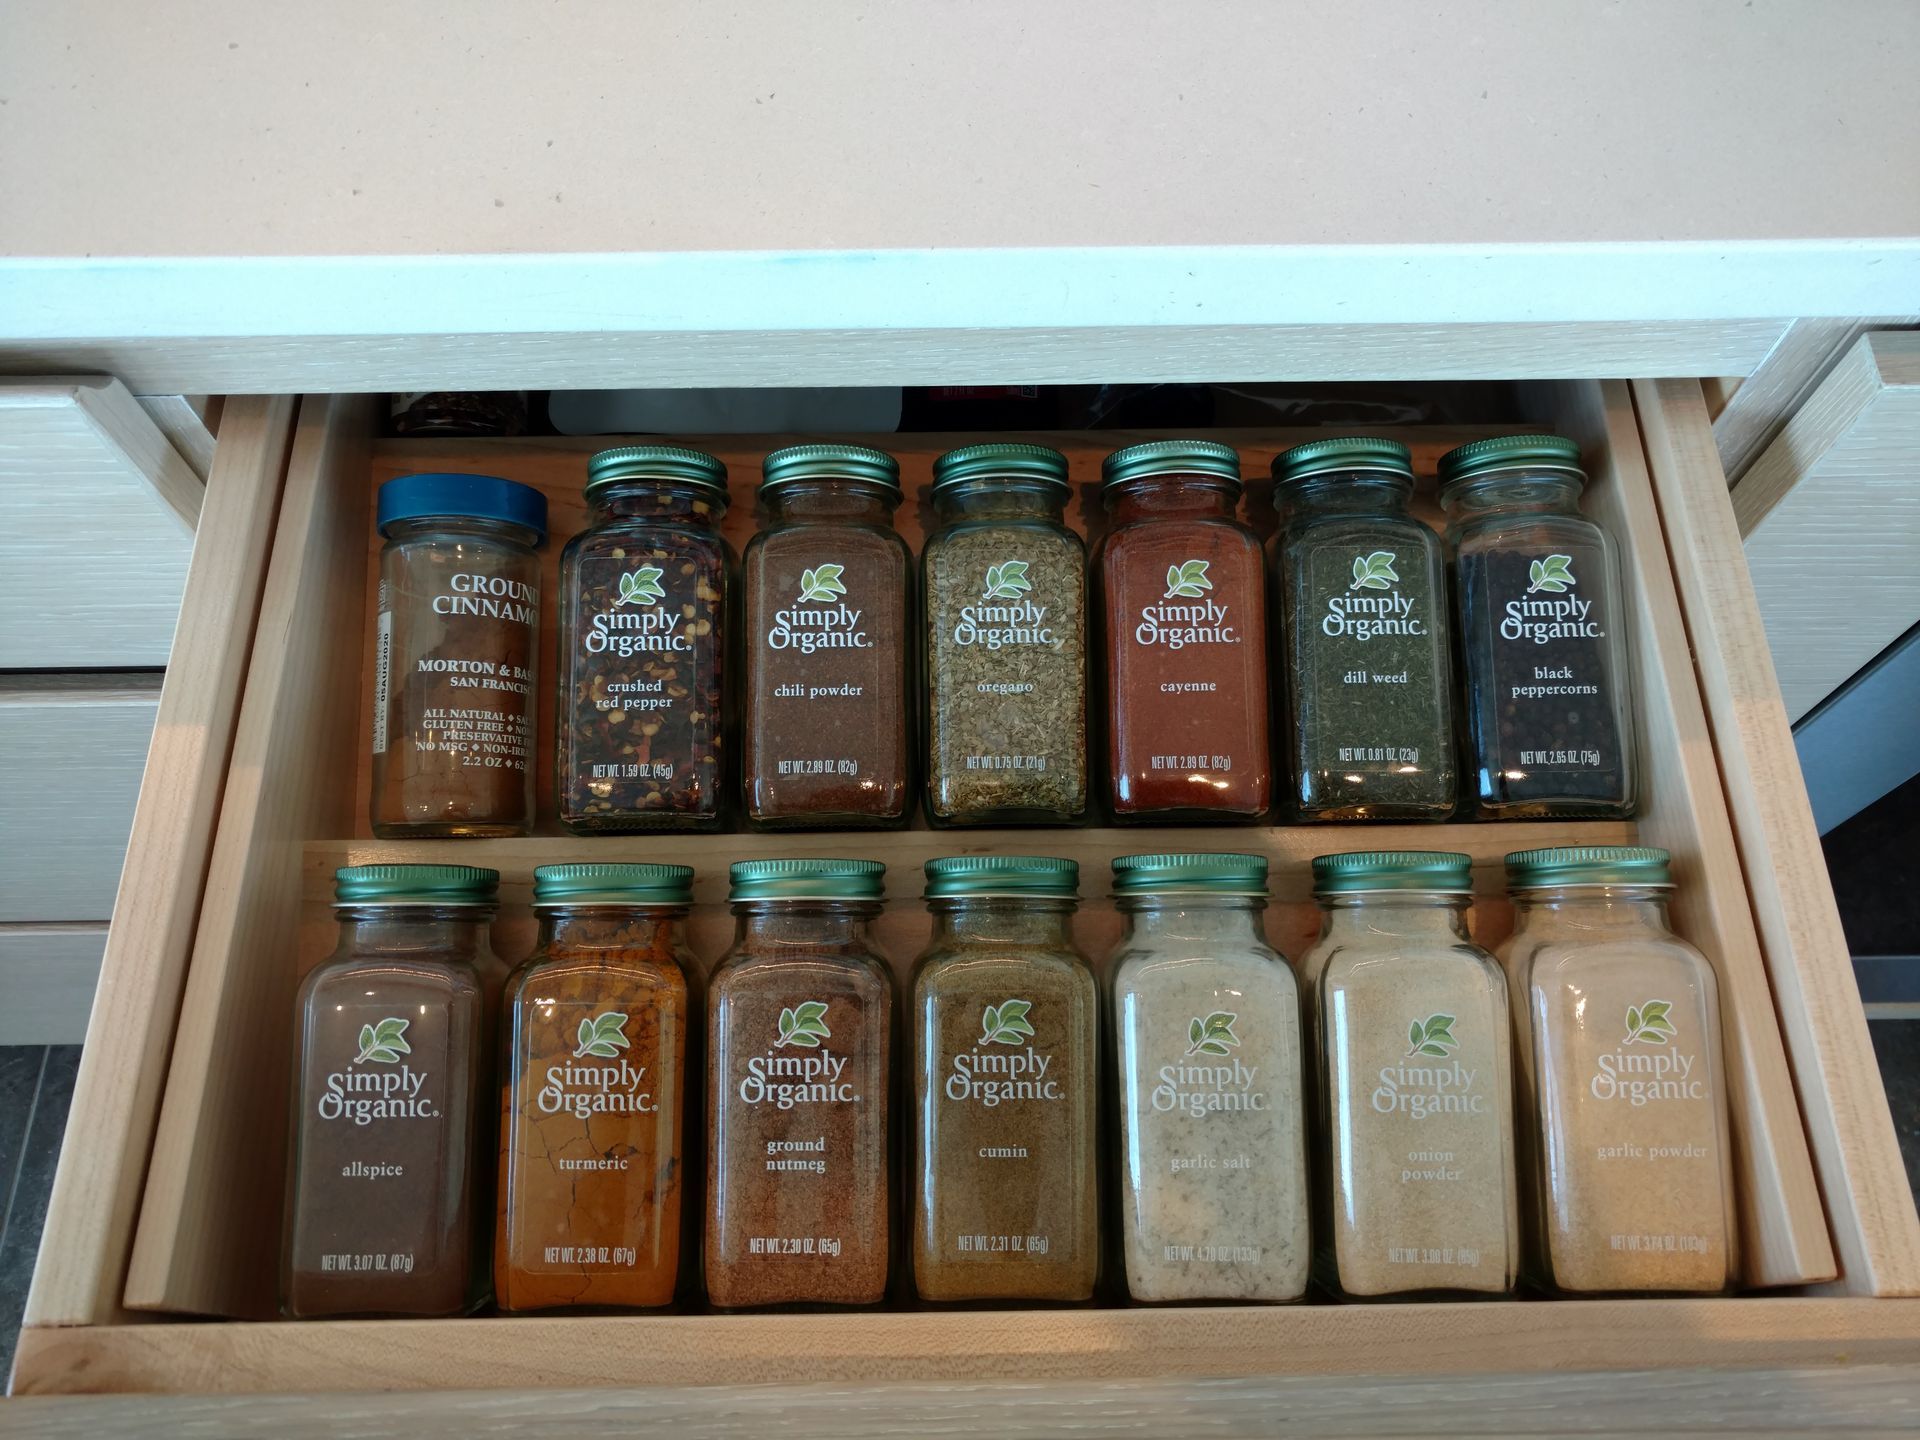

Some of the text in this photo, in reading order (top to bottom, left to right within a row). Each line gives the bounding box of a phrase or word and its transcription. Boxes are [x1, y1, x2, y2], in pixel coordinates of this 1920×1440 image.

[961, 600, 1046, 627] Simply
[1142, 599, 1228, 626] Simply
[1328, 591, 1414, 618] Simply
[1506, 594, 1592, 621] Simply
[593, 607, 680, 634] Simply
[775, 604, 861, 631] Simply
[1136, 623, 1235, 649] Organic
[1322, 614, 1422, 640] Organic
[1500, 617, 1600, 644] Organic
[585, 630, 685, 657] Organic
[768, 627, 867, 654] Organic
[954, 623, 1052, 650] Organic
[380, 632, 389, 702] 05AUG2020
[418, 660, 495, 674] MORTON
[499, 665, 510, 677] &
[1534, 667, 1573, 679] black
[451, 677, 479, 687] SAN
[607, 679, 662, 692] crushed
[1344, 672, 1408, 683] dill weed
[774, 684, 862, 699] chili powder
[977, 683, 1033, 694] oregano
[1160, 681, 1216, 694] cayenne
[1512, 684, 1598, 698] peppercorns
[596, 697, 672, 710] red pepper
[424, 709, 446, 718] ALL
[450, 709, 505, 721] NATURAL
[423, 720, 473, 730] GLUTEN
[477, 722, 504, 732] FREE
[416, 742, 435, 751] NO
[439, 742, 468, 751] MSG
[443, 731, 522, 746] PRESERVATIVE
[463, 757, 481, 766] 2.2
[484, 758, 502, 767] OZ
[967, 757, 980, 769] NET
[995, 757, 1011, 768] 0.75
[1026, 756, 1046, 771] (21g)
[1152, 756, 1165, 769] NET
[1181, 756, 1197, 768] 2.89
[1199, 756, 1209, 768] OZ.
[1212, 755, 1231, 771] (82g)
[1339, 748, 1352, 761] NET
[1369, 748, 1384, 761] 0.81
[1399, 748, 1419, 763] (23g)
[1521, 751, 1535, 764] NET
[1550, 751, 1566, 763] 2.65
[1581, 750, 1600, 766] (75g)
[592, 765, 607, 777] NET
[622, 765, 638, 777] 1.59
[653, 764, 673, 778] (45g)
[778, 761, 792, 774] NET
[807, 761, 823, 773] 2.89
[838, 760, 858, 775] (82g)
[748, 1050, 847, 1082] Simply
[953, 1047, 1052, 1080] Simply
[1598, 1047, 1695, 1080] Simply
[328, 1065, 427, 1098] Simply
[547, 1059, 645, 1092] Simply
[1159, 1059, 1258, 1091] Simply
[1379, 1060, 1476, 1093] Simply
[740, 1076, 853, 1109] Organic
[945, 1073, 1058, 1107] Organic
[1591, 1073, 1702, 1106] Organic
[318, 1092, 432, 1125] Organic
[538, 1086, 651, 1119] Organic
[1152, 1085, 1265, 1118] Organic
[1371, 1086, 1483, 1120] Organic
[767, 1137, 825, 1155] ground
[979, 1144, 1028, 1158] cumin
[1409, 1147, 1454, 1161] onion
[1597, 1143, 1707, 1161] garlic powder
[342, 1162, 403, 1179] allspice
[559, 1156, 628, 1170] turmeric
[766, 1159, 825, 1174] nutmeg
[1171, 1155, 1250, 1172] garlic salt
[1402, 1168, 1460, 1183] powder
[750, 1238, 765, 1253] NET
[782, 1238, 801, 1253] 2.30
[818, 1238, 840, 1256] (65g)
[958, 1236, 974, 1251] NET
[991, 1236, 1008, 1251] 2.31
[1012, 1236, 1024, 1251] OZ.
[1027, 1235, 1049, 1254] (65g)
[1164, 1246, 1180, 1261] NET
[322, 1255, 338, 1271] NET
[354, 1255, 373, 1270] 3.07
[391, 1254, 414, 1273] (87g)
[544, 1248, 560, 1263] NET
[578, 1248, 595, 1263] 2.38
[599, 1248, 610, 1263] OZ.
[613, 1247, 636, 1266] (67g)
